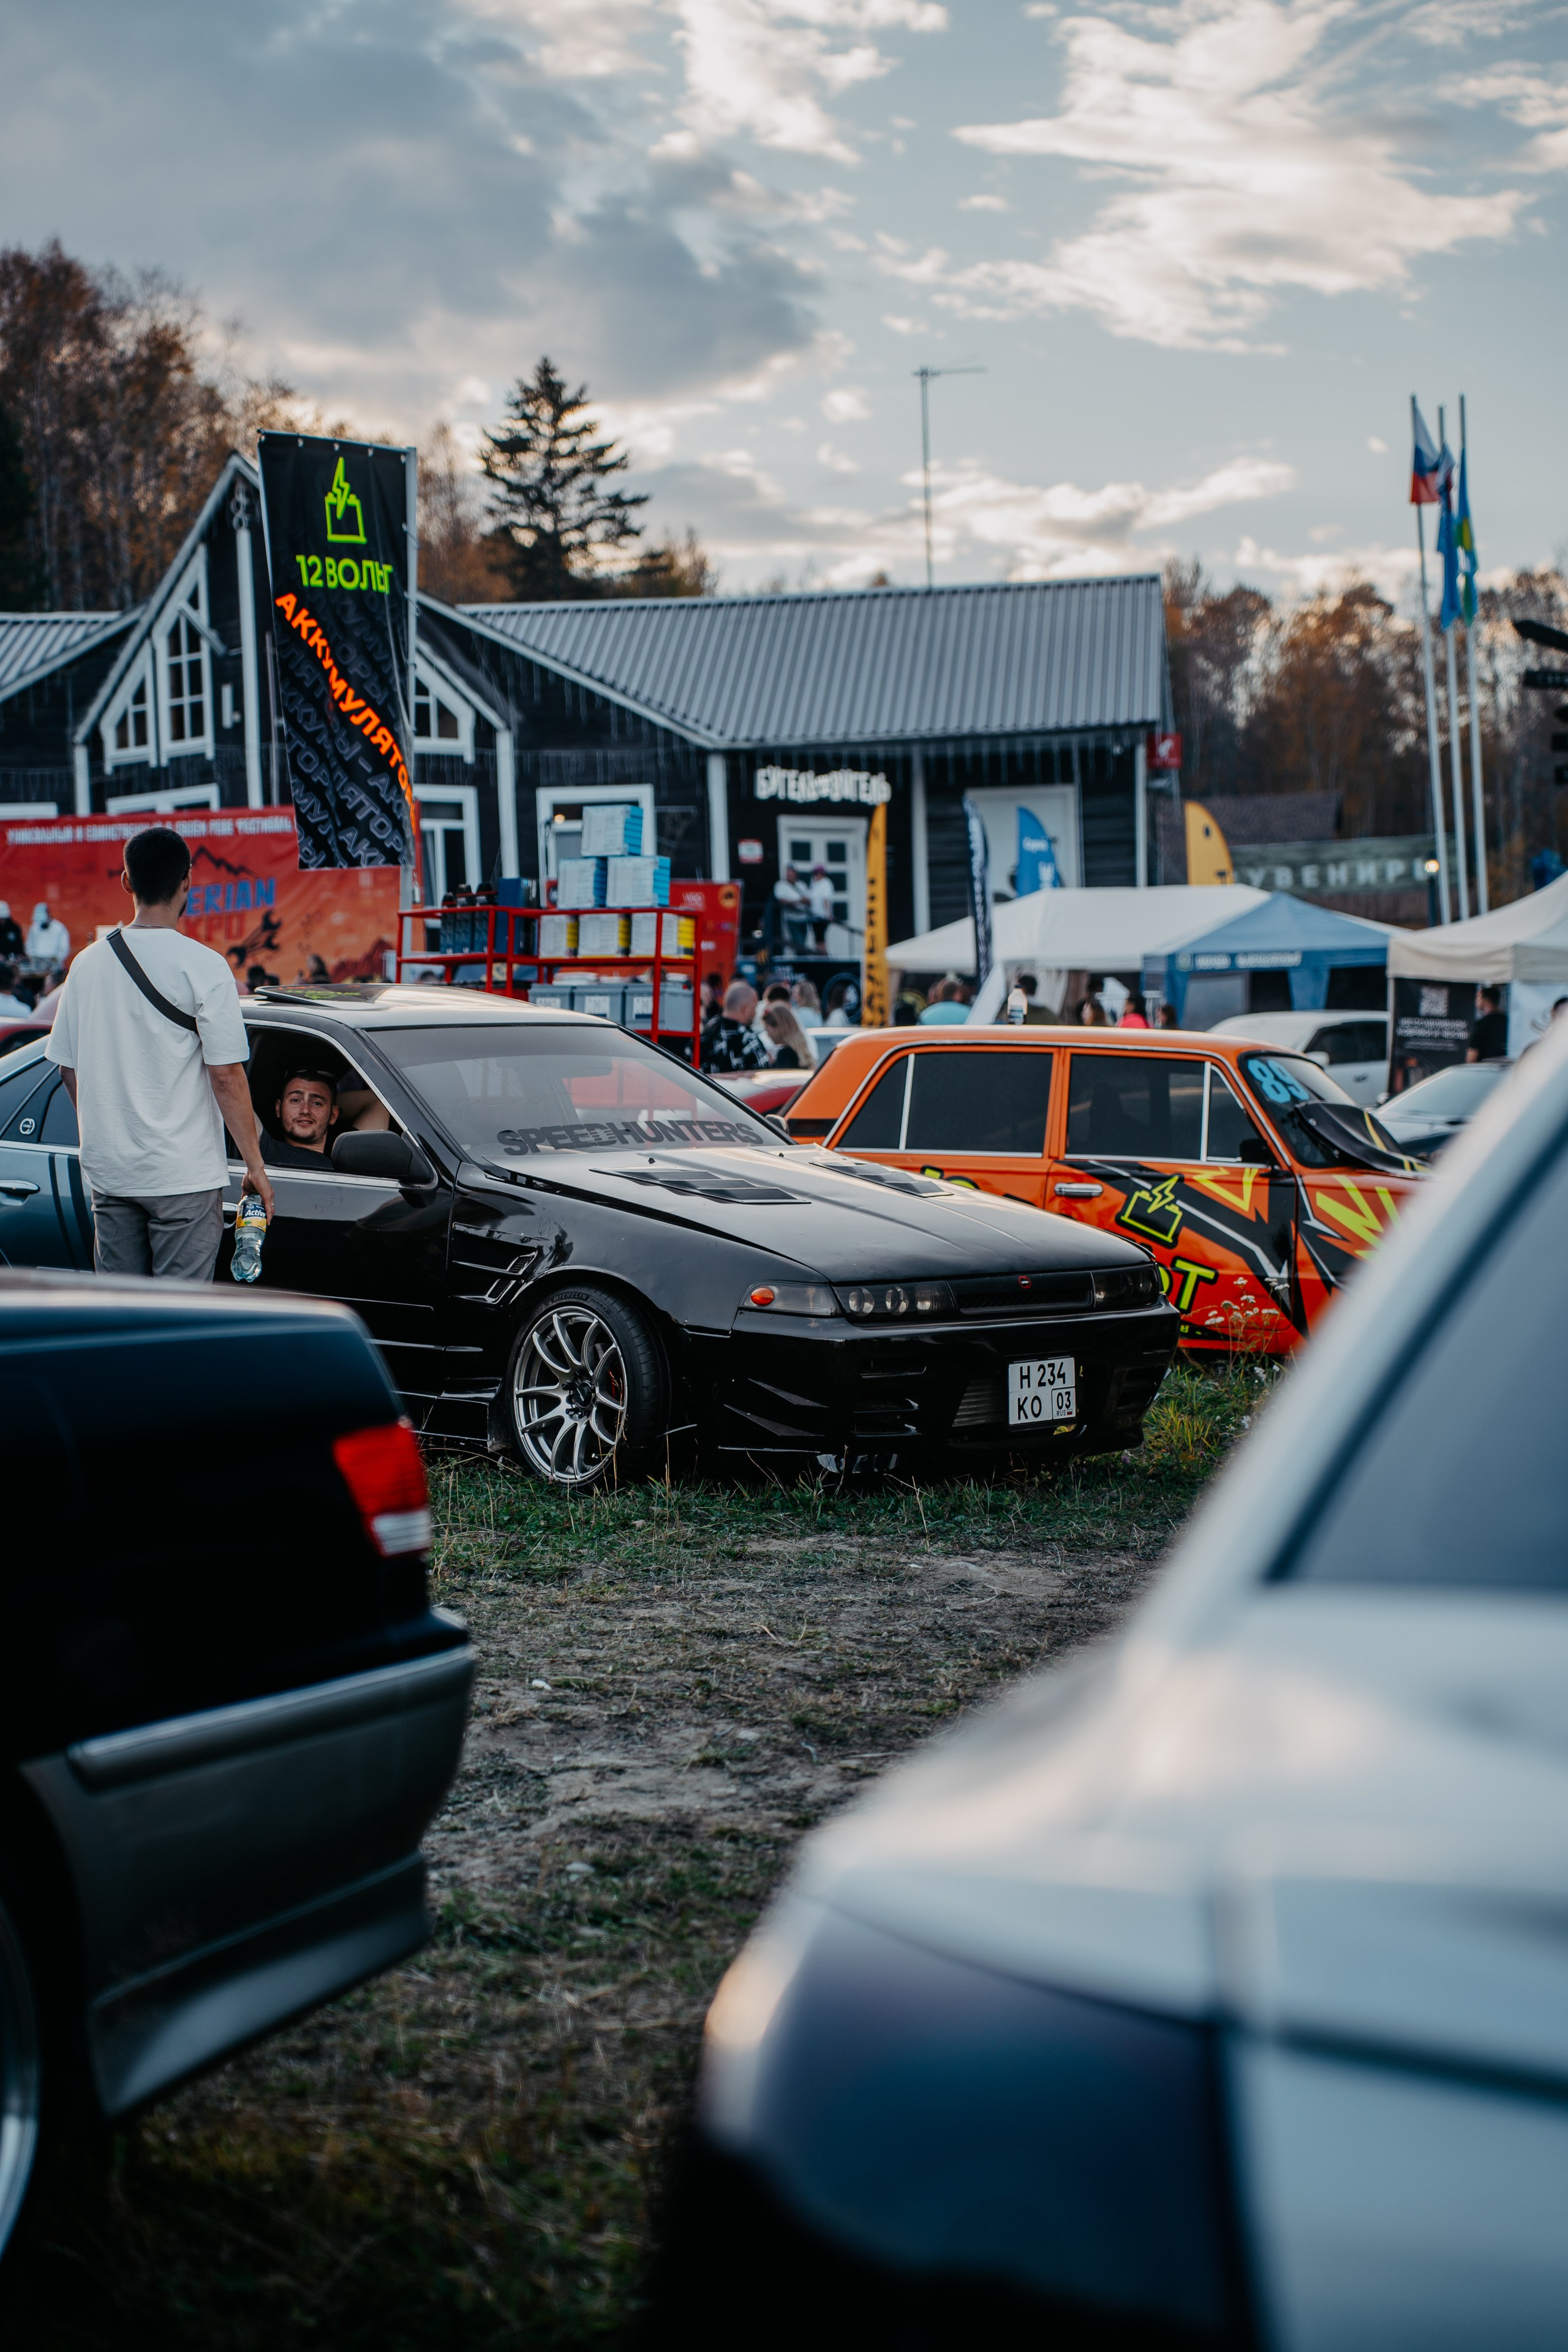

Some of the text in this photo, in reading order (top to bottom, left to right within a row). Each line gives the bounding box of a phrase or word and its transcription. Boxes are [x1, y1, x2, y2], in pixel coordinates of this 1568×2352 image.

[186, 877, 276, 916] ERIAN
[1248, 1058, 1310, 1104] 89
[497, 1120, 764, 1155] SPEEDHUNTERS
[245, 1208, 266, 1218] Active
[553, 1292, 587, 1302] MICHELIN
[1037, 1362, 1066, 1387] 234
[1057, 1391, 1071, 1409] 03
